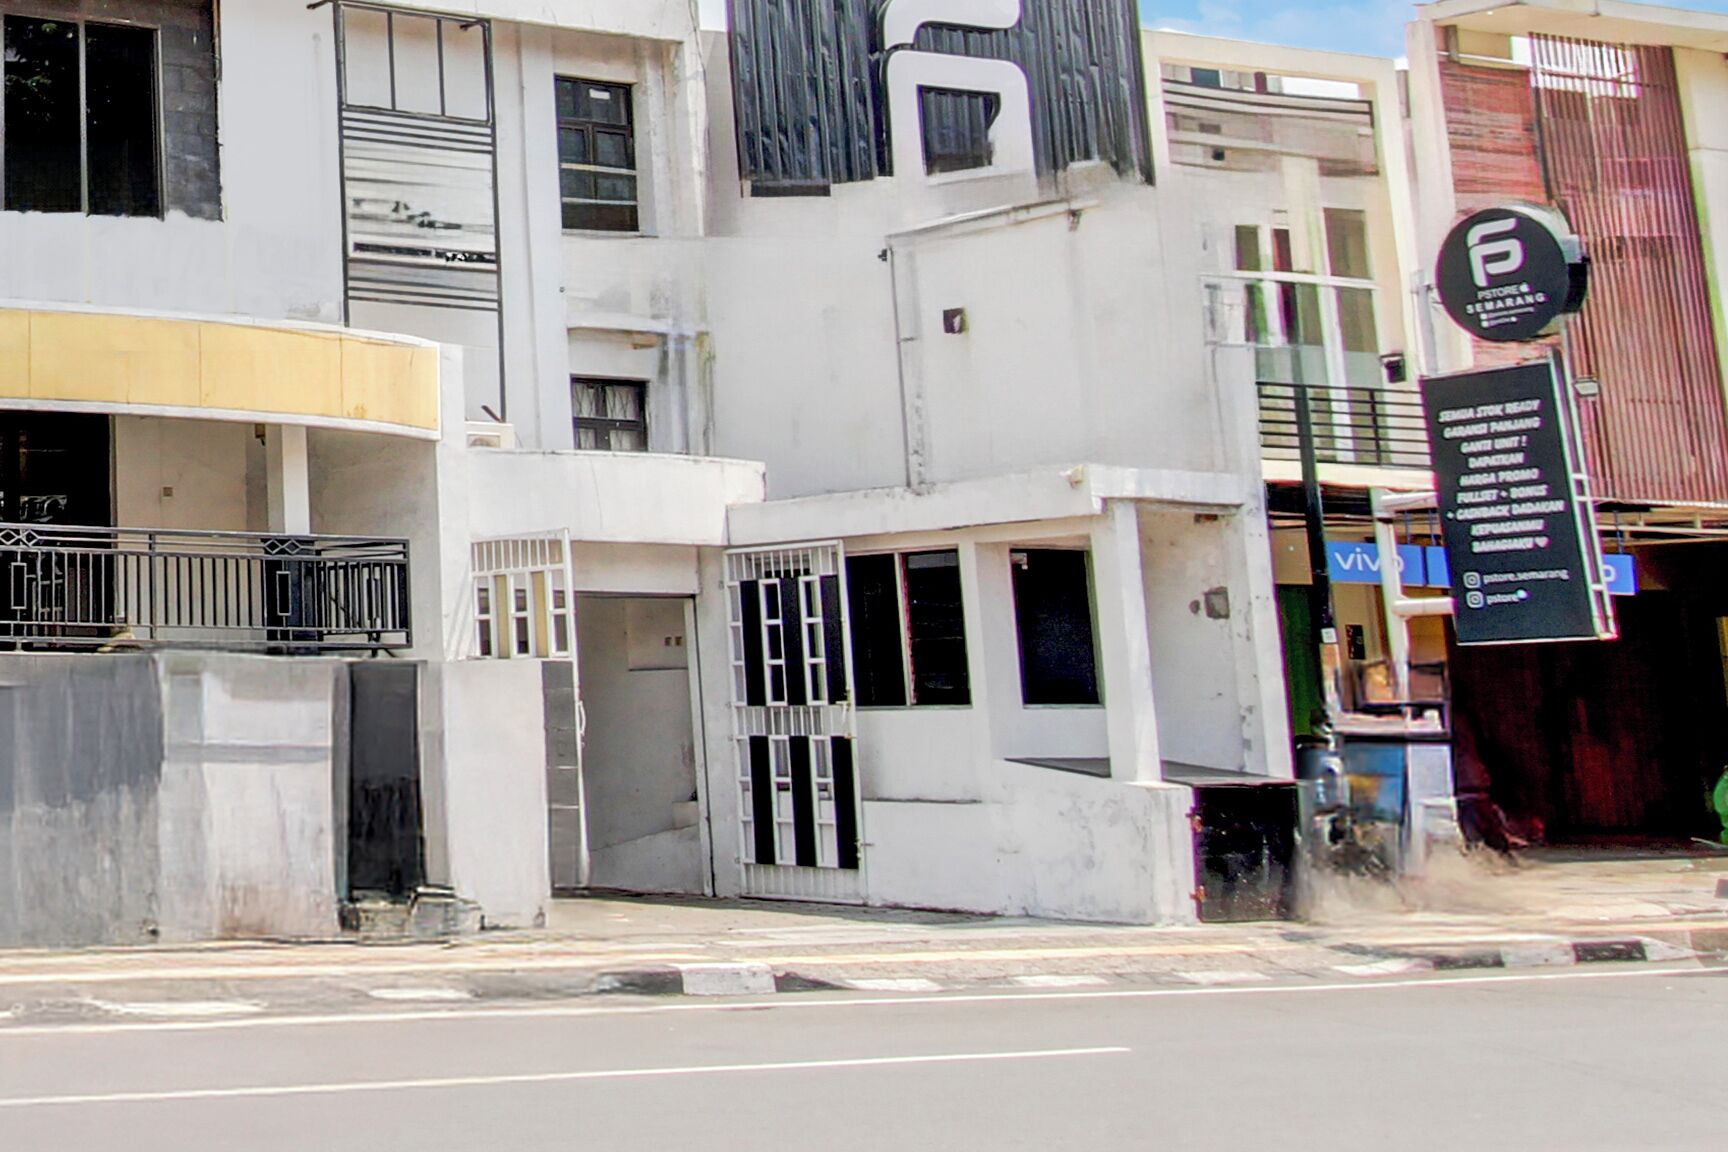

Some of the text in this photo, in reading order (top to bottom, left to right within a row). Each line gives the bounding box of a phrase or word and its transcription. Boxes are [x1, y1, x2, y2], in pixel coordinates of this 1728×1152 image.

[1477, 286, 1520, 301] PSTORE
[1465, 291, 1547, 314] SEMARANG
[1475, 404, 1504, 418] STOK
[1504, 399, 1541, 414] READY
[1497, 467, 1540, 483] PROMO
[1509, 483, 1548, 499] BONUS
[1482, 569, 1571, 586] pstore.semarang
